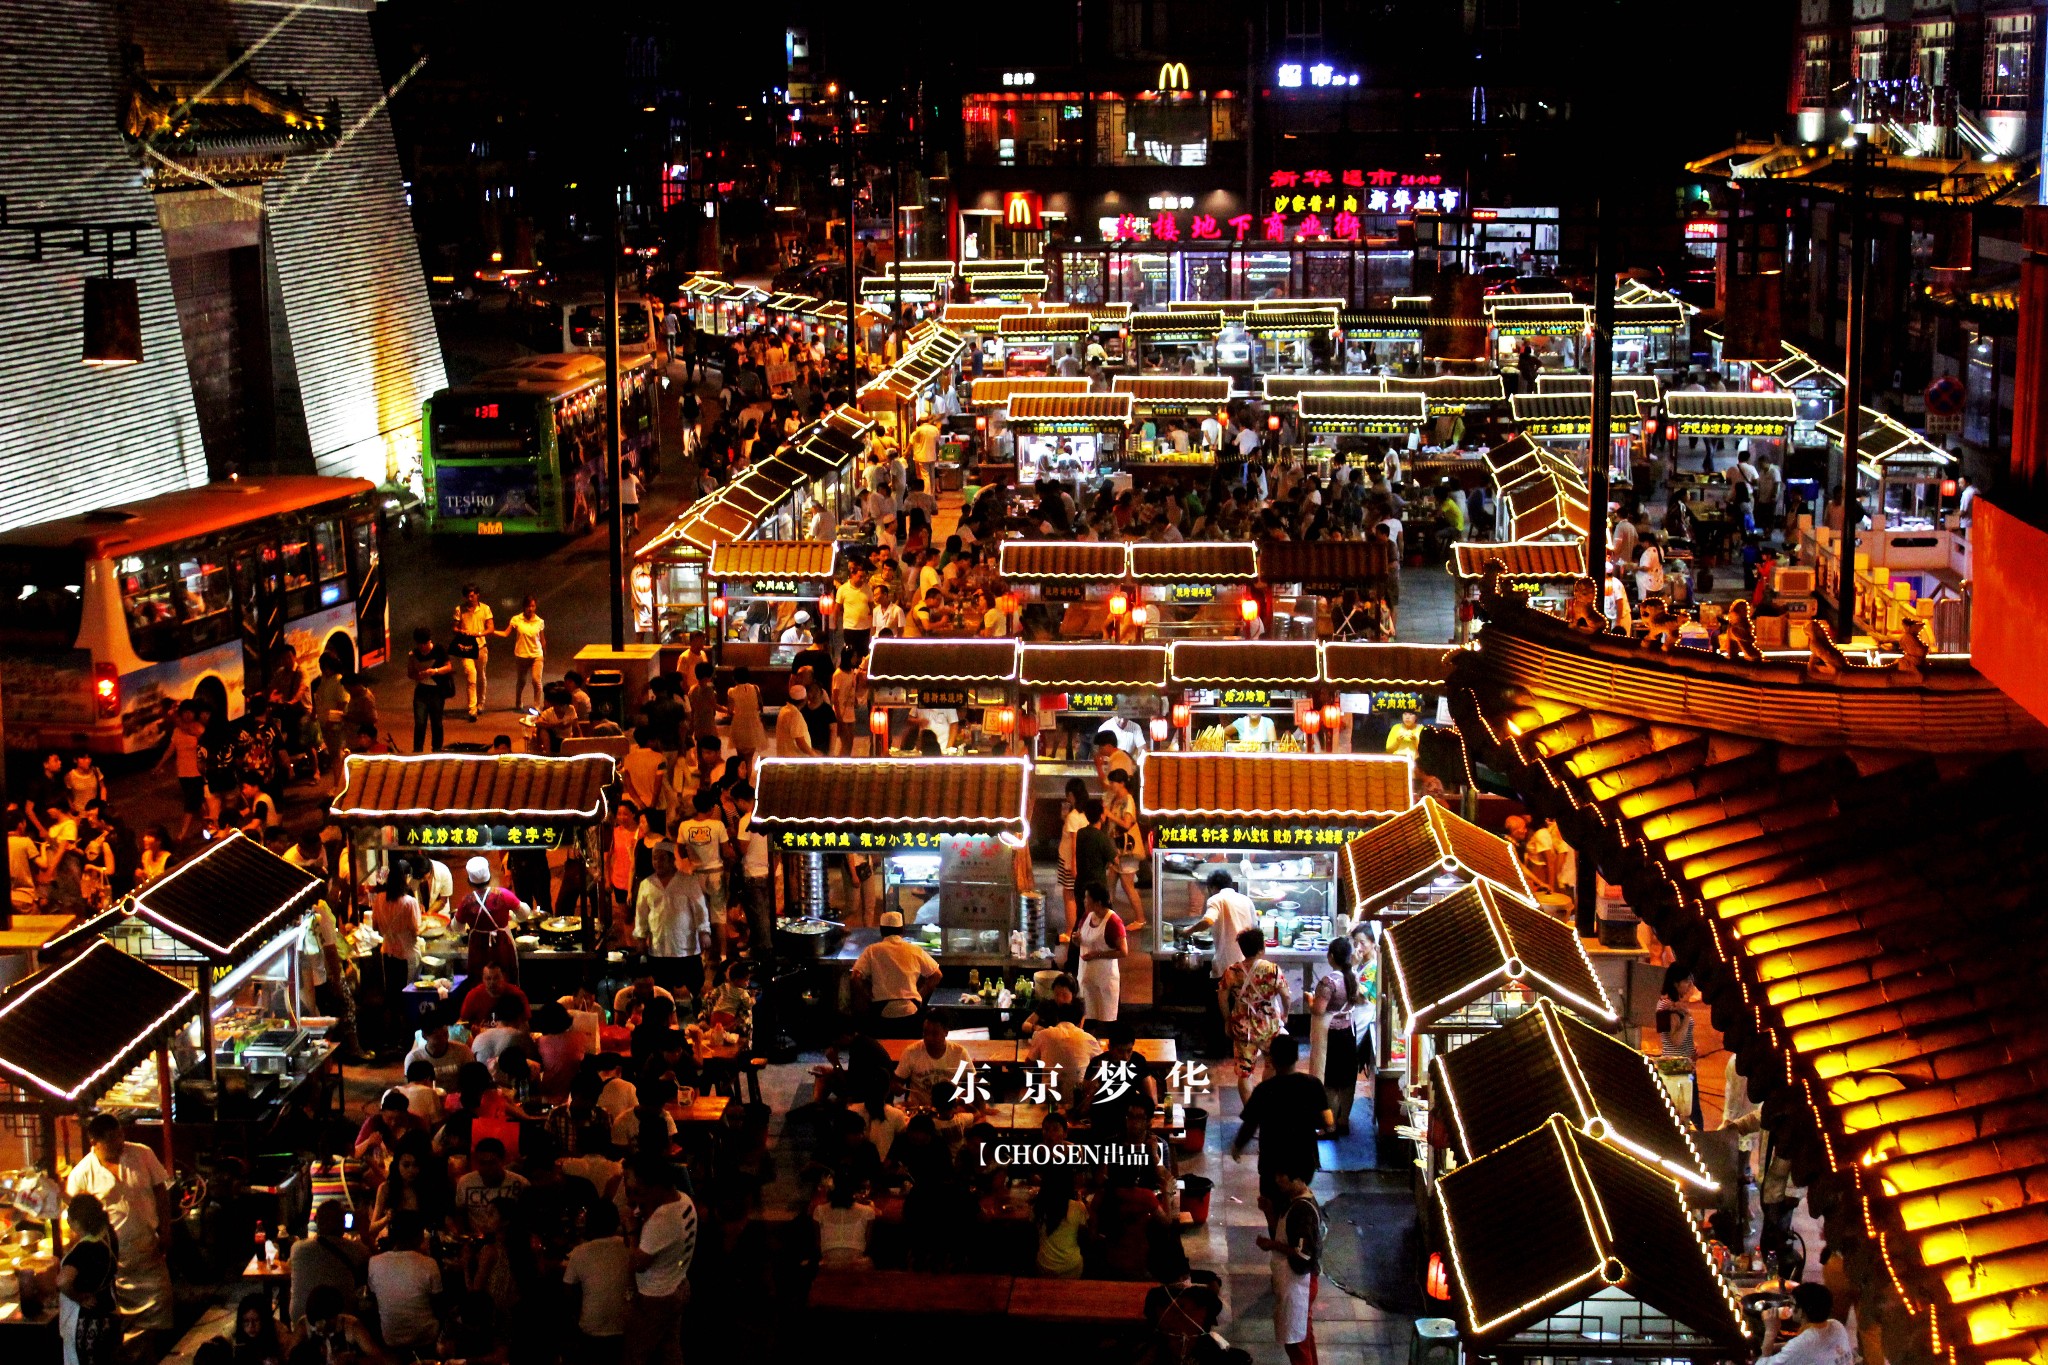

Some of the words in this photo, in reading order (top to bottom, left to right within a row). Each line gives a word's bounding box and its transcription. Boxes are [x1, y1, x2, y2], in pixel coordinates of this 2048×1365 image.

[1680, 422, 1732, 435] 方记炒凉粉
[1733, 423, 1785, 436] 方记炒凉粉
[406, 827, 480, 844] 小虎炒凉粉
[507, 826, 556, 844] 老字号
